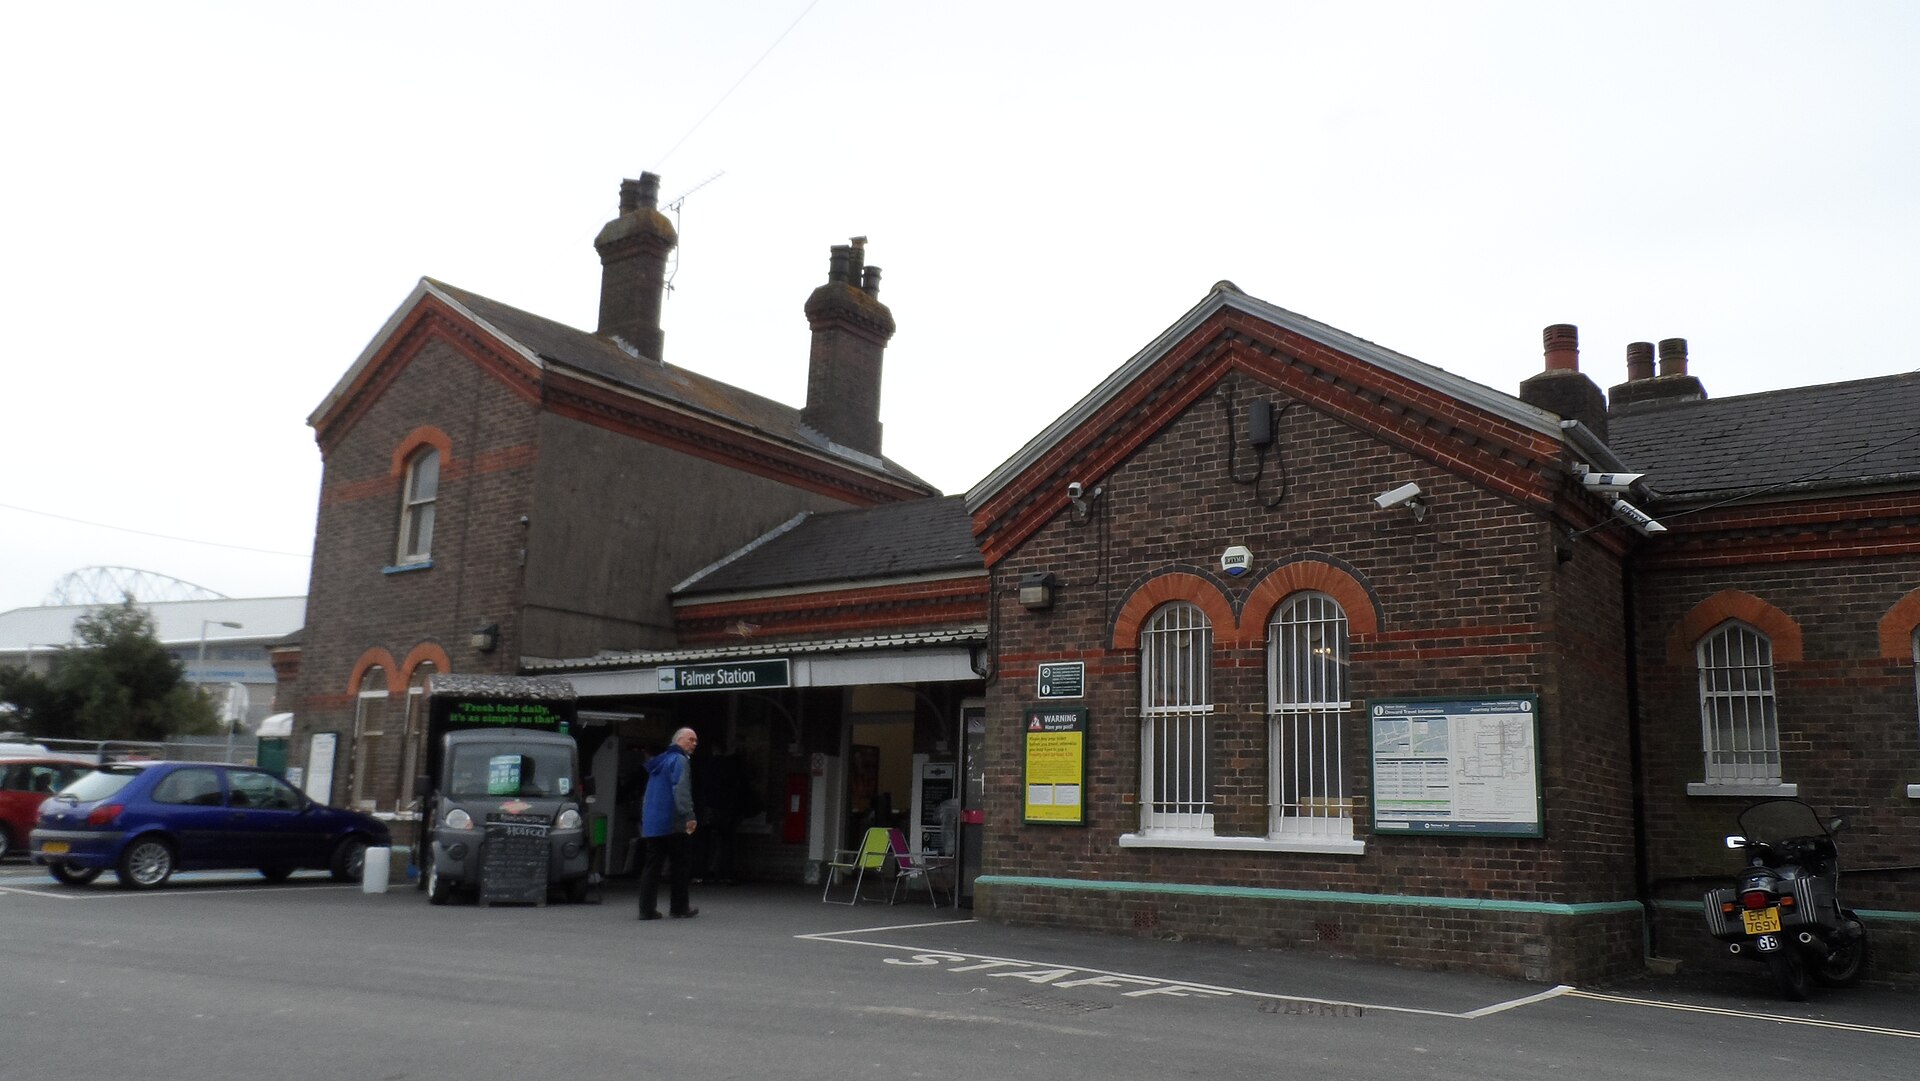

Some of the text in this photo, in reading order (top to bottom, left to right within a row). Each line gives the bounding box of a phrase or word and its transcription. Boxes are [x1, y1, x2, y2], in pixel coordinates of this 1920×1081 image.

[681, 668, 756, 686] Falmer Station
[497, 704, 519, 712] food
[482, 714, 518, 724] simple
[1044, 714, 1077, 723] WARNING
[1748, 910, 1773, 921] EFL
[1746, 920, 1778, 932] 769Y
[1759, 936, 1777, 949] GB
[883, 953, 1233, 997] STAFF
